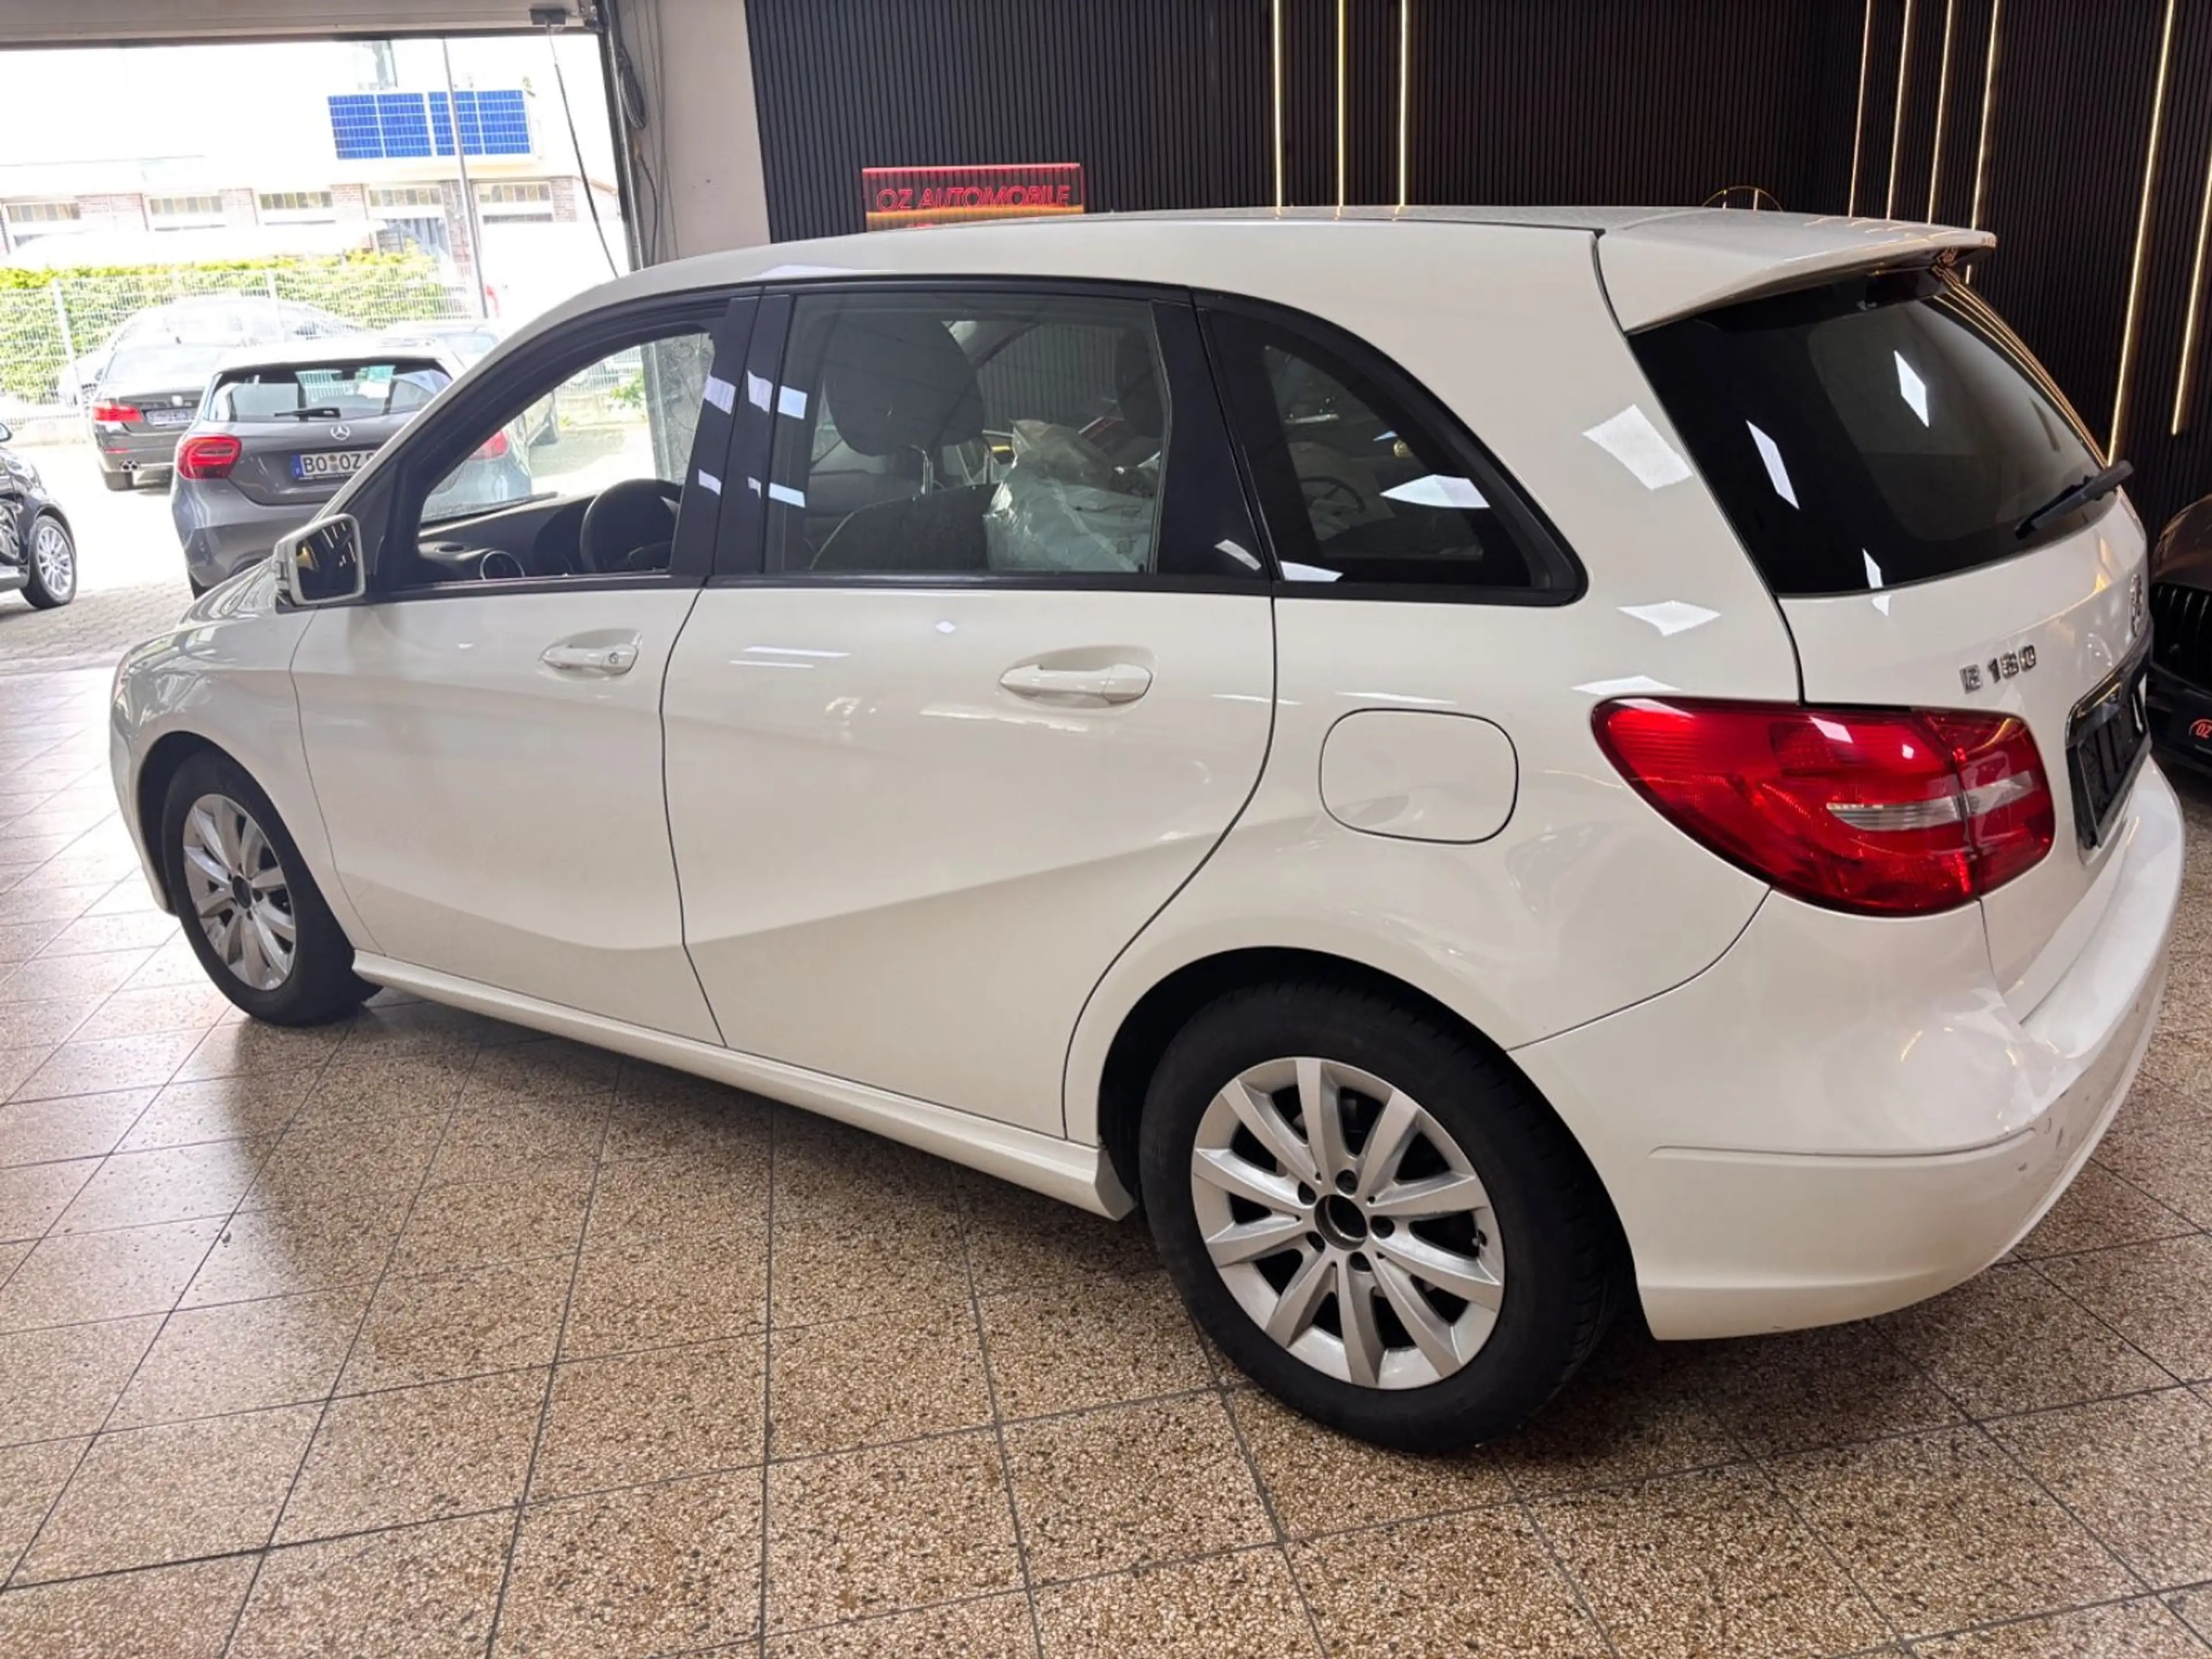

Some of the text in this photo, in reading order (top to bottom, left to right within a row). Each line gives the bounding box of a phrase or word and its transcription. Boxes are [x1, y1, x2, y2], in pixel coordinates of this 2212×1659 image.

[876, 185, 1070, 211] OZ AUTOMOBILE
[303, 456, 327, 473] BO
